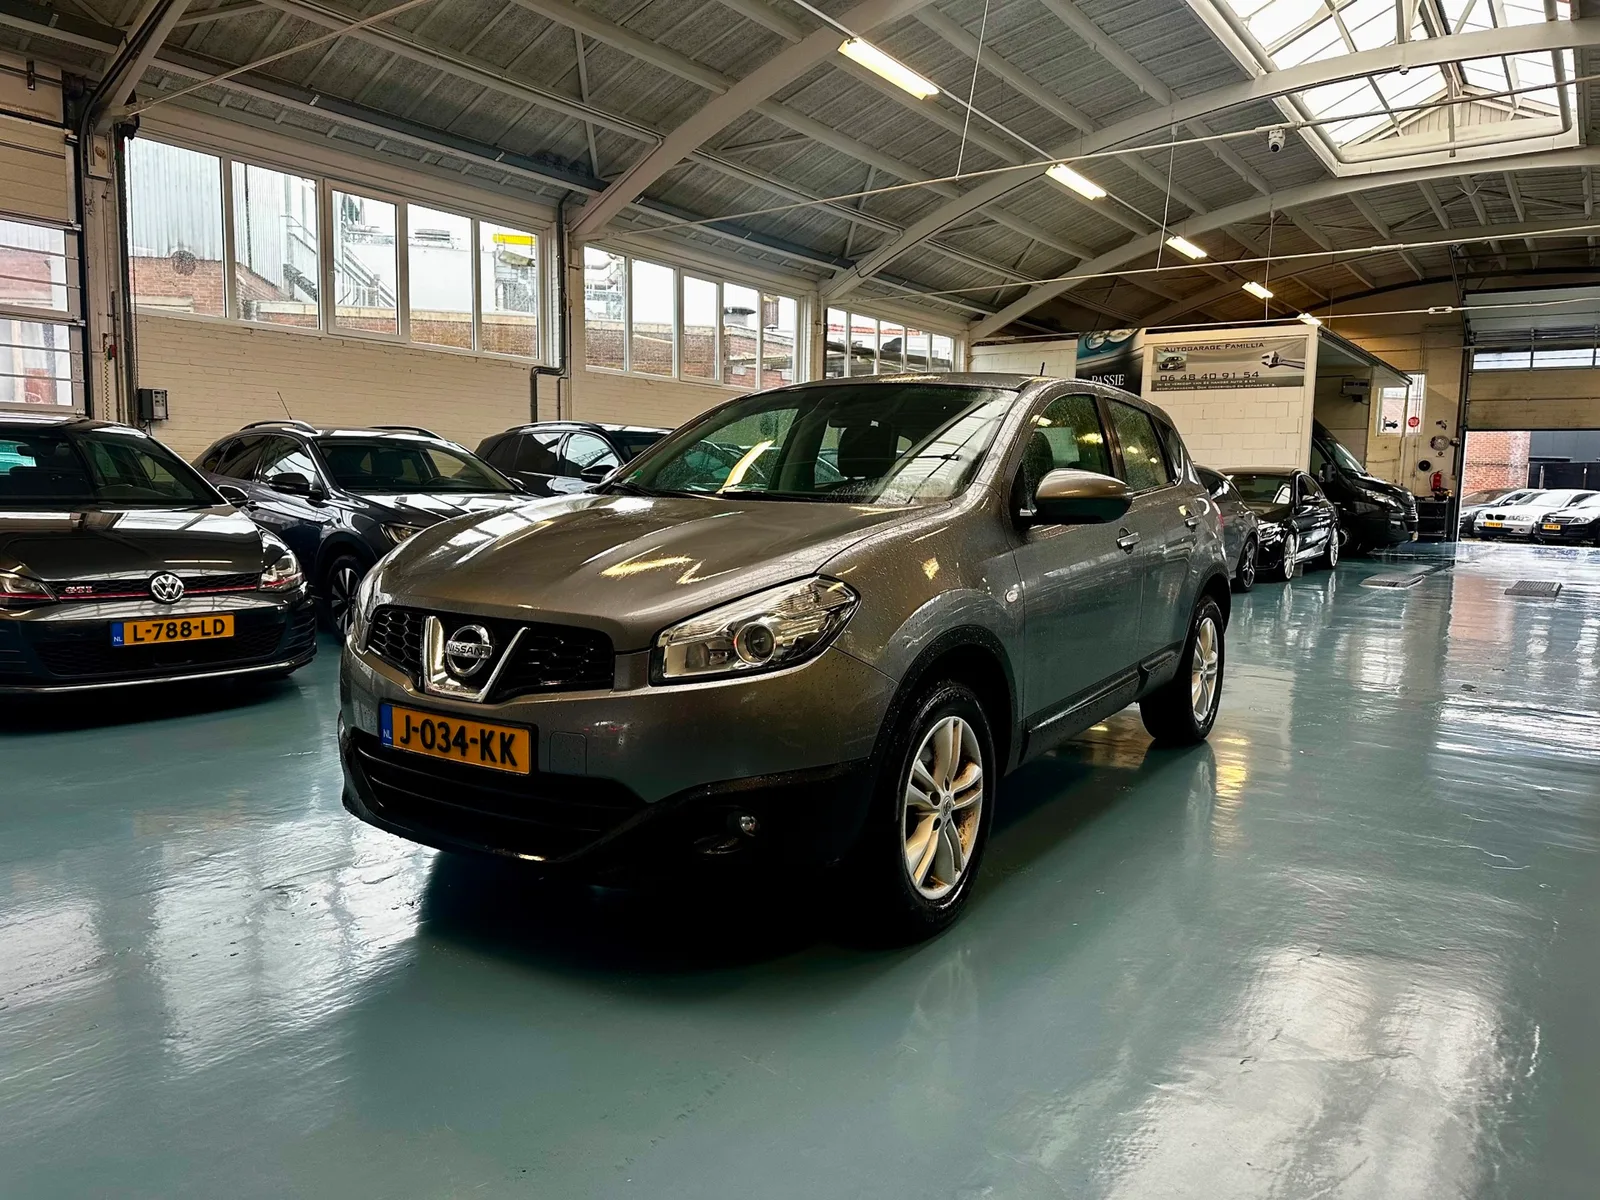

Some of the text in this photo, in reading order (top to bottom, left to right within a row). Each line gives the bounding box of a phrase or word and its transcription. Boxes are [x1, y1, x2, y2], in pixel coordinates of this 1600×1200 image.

[1091, 374, 1125, 386] PASSIE
[1180, 373, 1196, 381] 48
[1201, 372, 1217, 380] 40
[1222, 371, 1237, 380] 91
[1243, 370, 1260, 379] 54
[65, 585, 93, 595] GTI
[133, 618, 226, 643] L-788-LD
[447, 643, 484, 656] NISSAN
[383, 728, 392, 740] NL
[399, 714, 518, 767] J-034-KK
